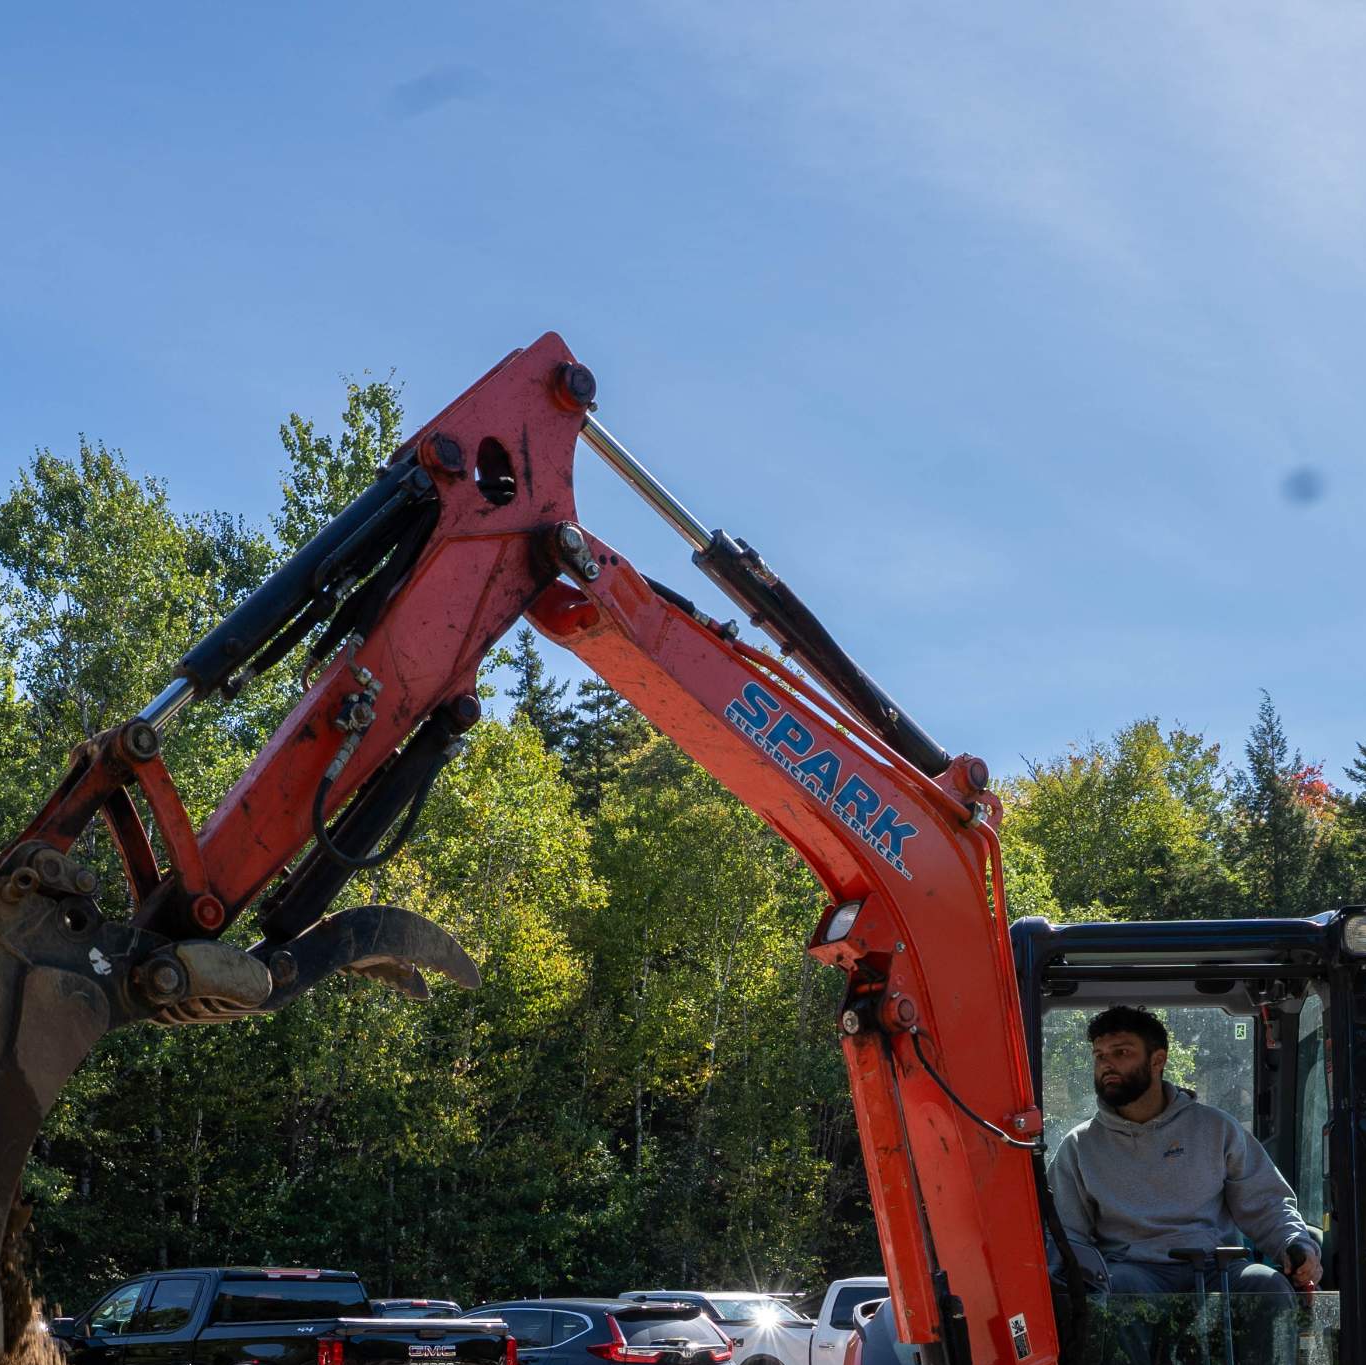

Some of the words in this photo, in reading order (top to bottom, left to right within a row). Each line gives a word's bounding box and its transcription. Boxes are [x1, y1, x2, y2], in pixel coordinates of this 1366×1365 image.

[724, 704, 829, 805] ELECTRICIAN
[831, 802, 905, 872] SERVICES
[725, 681, 920, 859] SPARK
[409, 1345, 456, 1356] GMC
